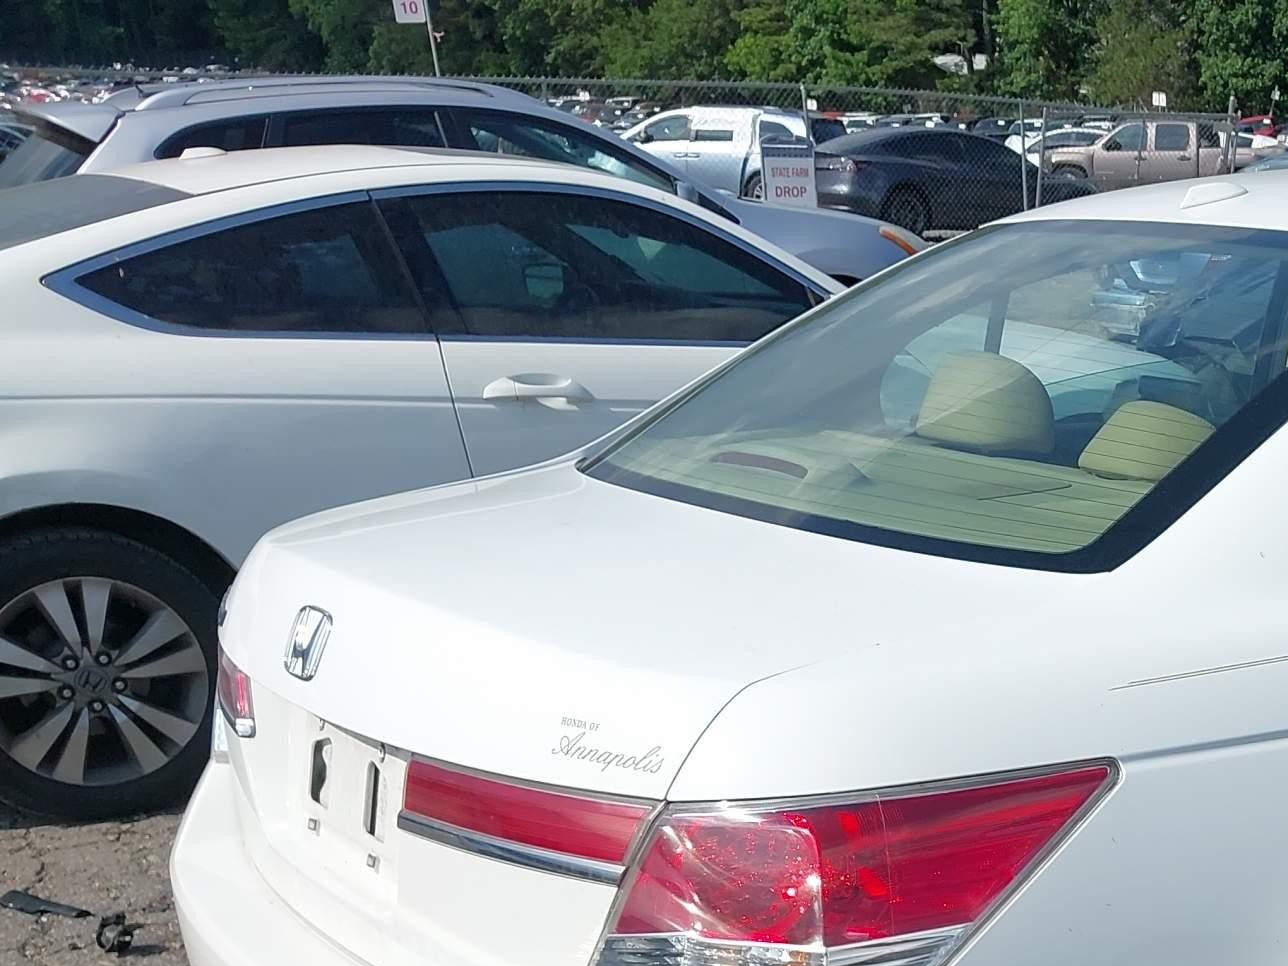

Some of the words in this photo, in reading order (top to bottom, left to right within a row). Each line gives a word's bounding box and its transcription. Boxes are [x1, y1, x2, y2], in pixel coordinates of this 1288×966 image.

[401, 1, 418, 15] 10
[771, 167, 790, 178] STATE
[791, 167, 809, 178] FARM
[775, 186, 807, 197] DROP
[561, 716, 587, 730] HONDA
[589, 722, 600, 731] OF
[551, 731, 665, 774] Annapolis
